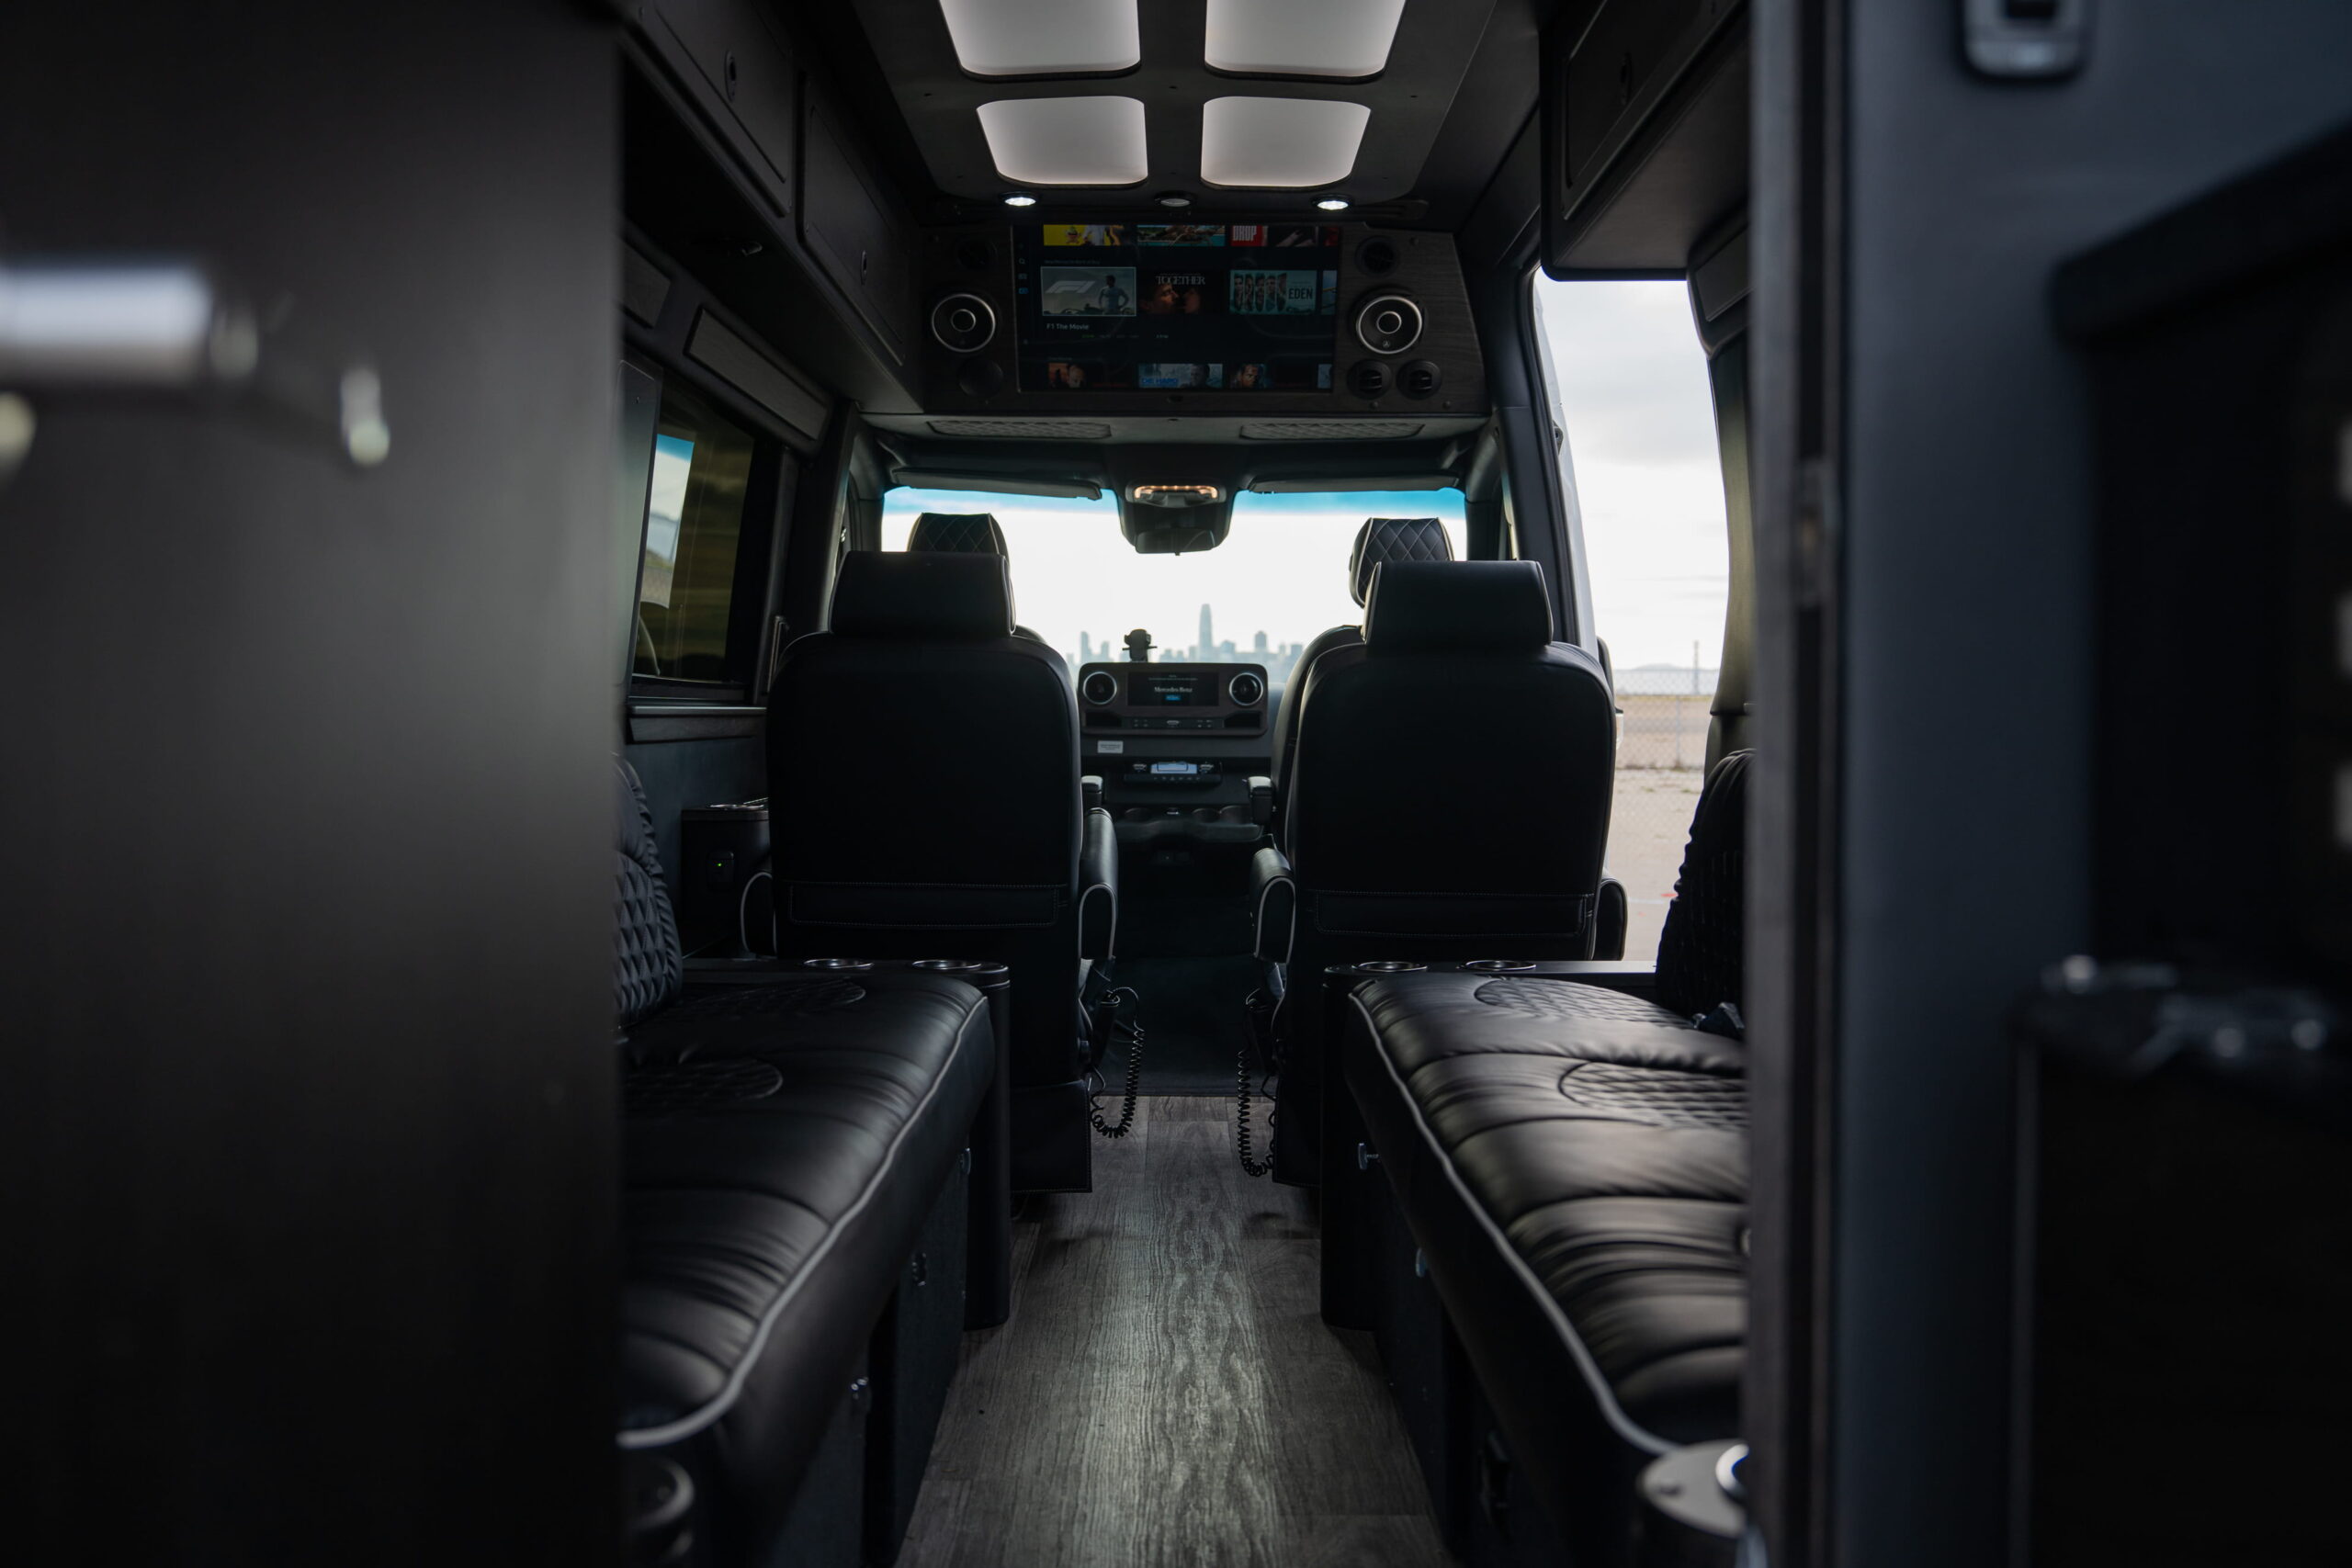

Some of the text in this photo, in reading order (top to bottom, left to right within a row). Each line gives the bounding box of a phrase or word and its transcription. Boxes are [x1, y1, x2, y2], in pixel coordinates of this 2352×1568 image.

[1233, 225, 1257, 242] DROP
[1155, 276, 1206, 286] TOGETHER
[1288, 288, 1314, 299] EDEN
